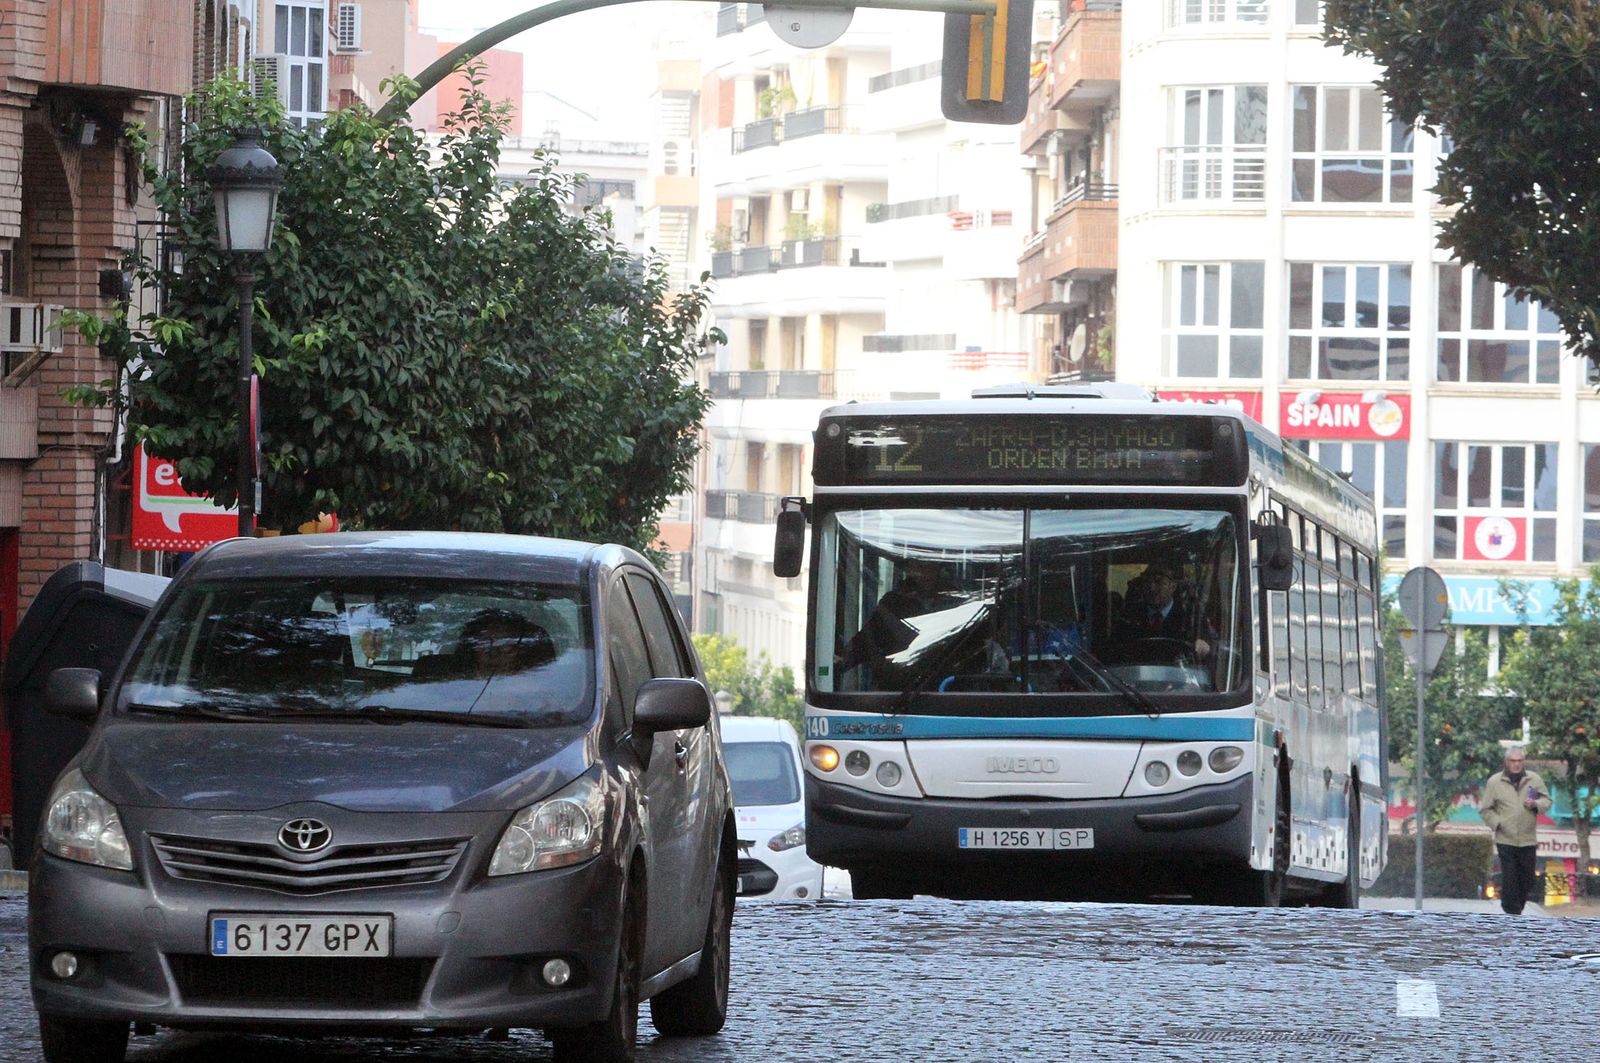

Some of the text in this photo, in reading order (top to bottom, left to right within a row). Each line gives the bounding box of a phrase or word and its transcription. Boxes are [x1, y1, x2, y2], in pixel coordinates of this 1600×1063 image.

[1286, 402, 1361, 428] SPAIN
[875, 425, 922, 471] 12
[987, 449, 1141, 469] ORDEN BAJA
[806, 717, 829, 737] 140
[986, 757, 1061, 774] IVECO
[974, 831, 984, 847] H
[992, 831, 1030, 847] 1256
[1036, 831, 1046, 847] Y
[1058, 831, 1089, 847] SP
[234, 923, 312, 952] 6137
[324, 923, 380, 952] GPX
